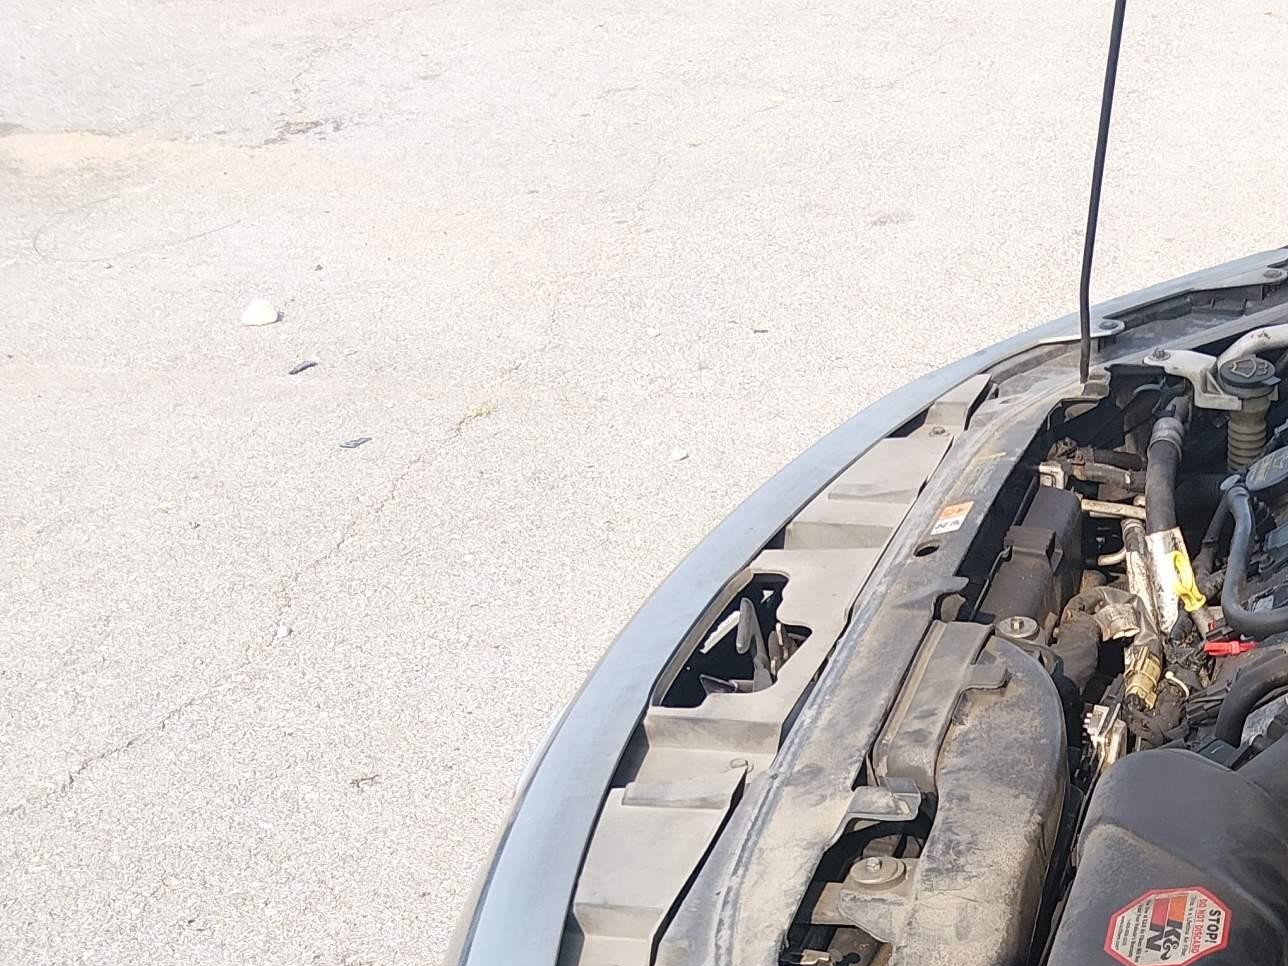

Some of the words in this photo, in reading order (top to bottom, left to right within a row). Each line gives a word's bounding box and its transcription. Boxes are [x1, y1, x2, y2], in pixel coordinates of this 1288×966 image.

[1197, 898, 1207, 908] DO
[1195, 909, 1205, 923] NOT
[1204, 909, 1222, 944] STOP!
